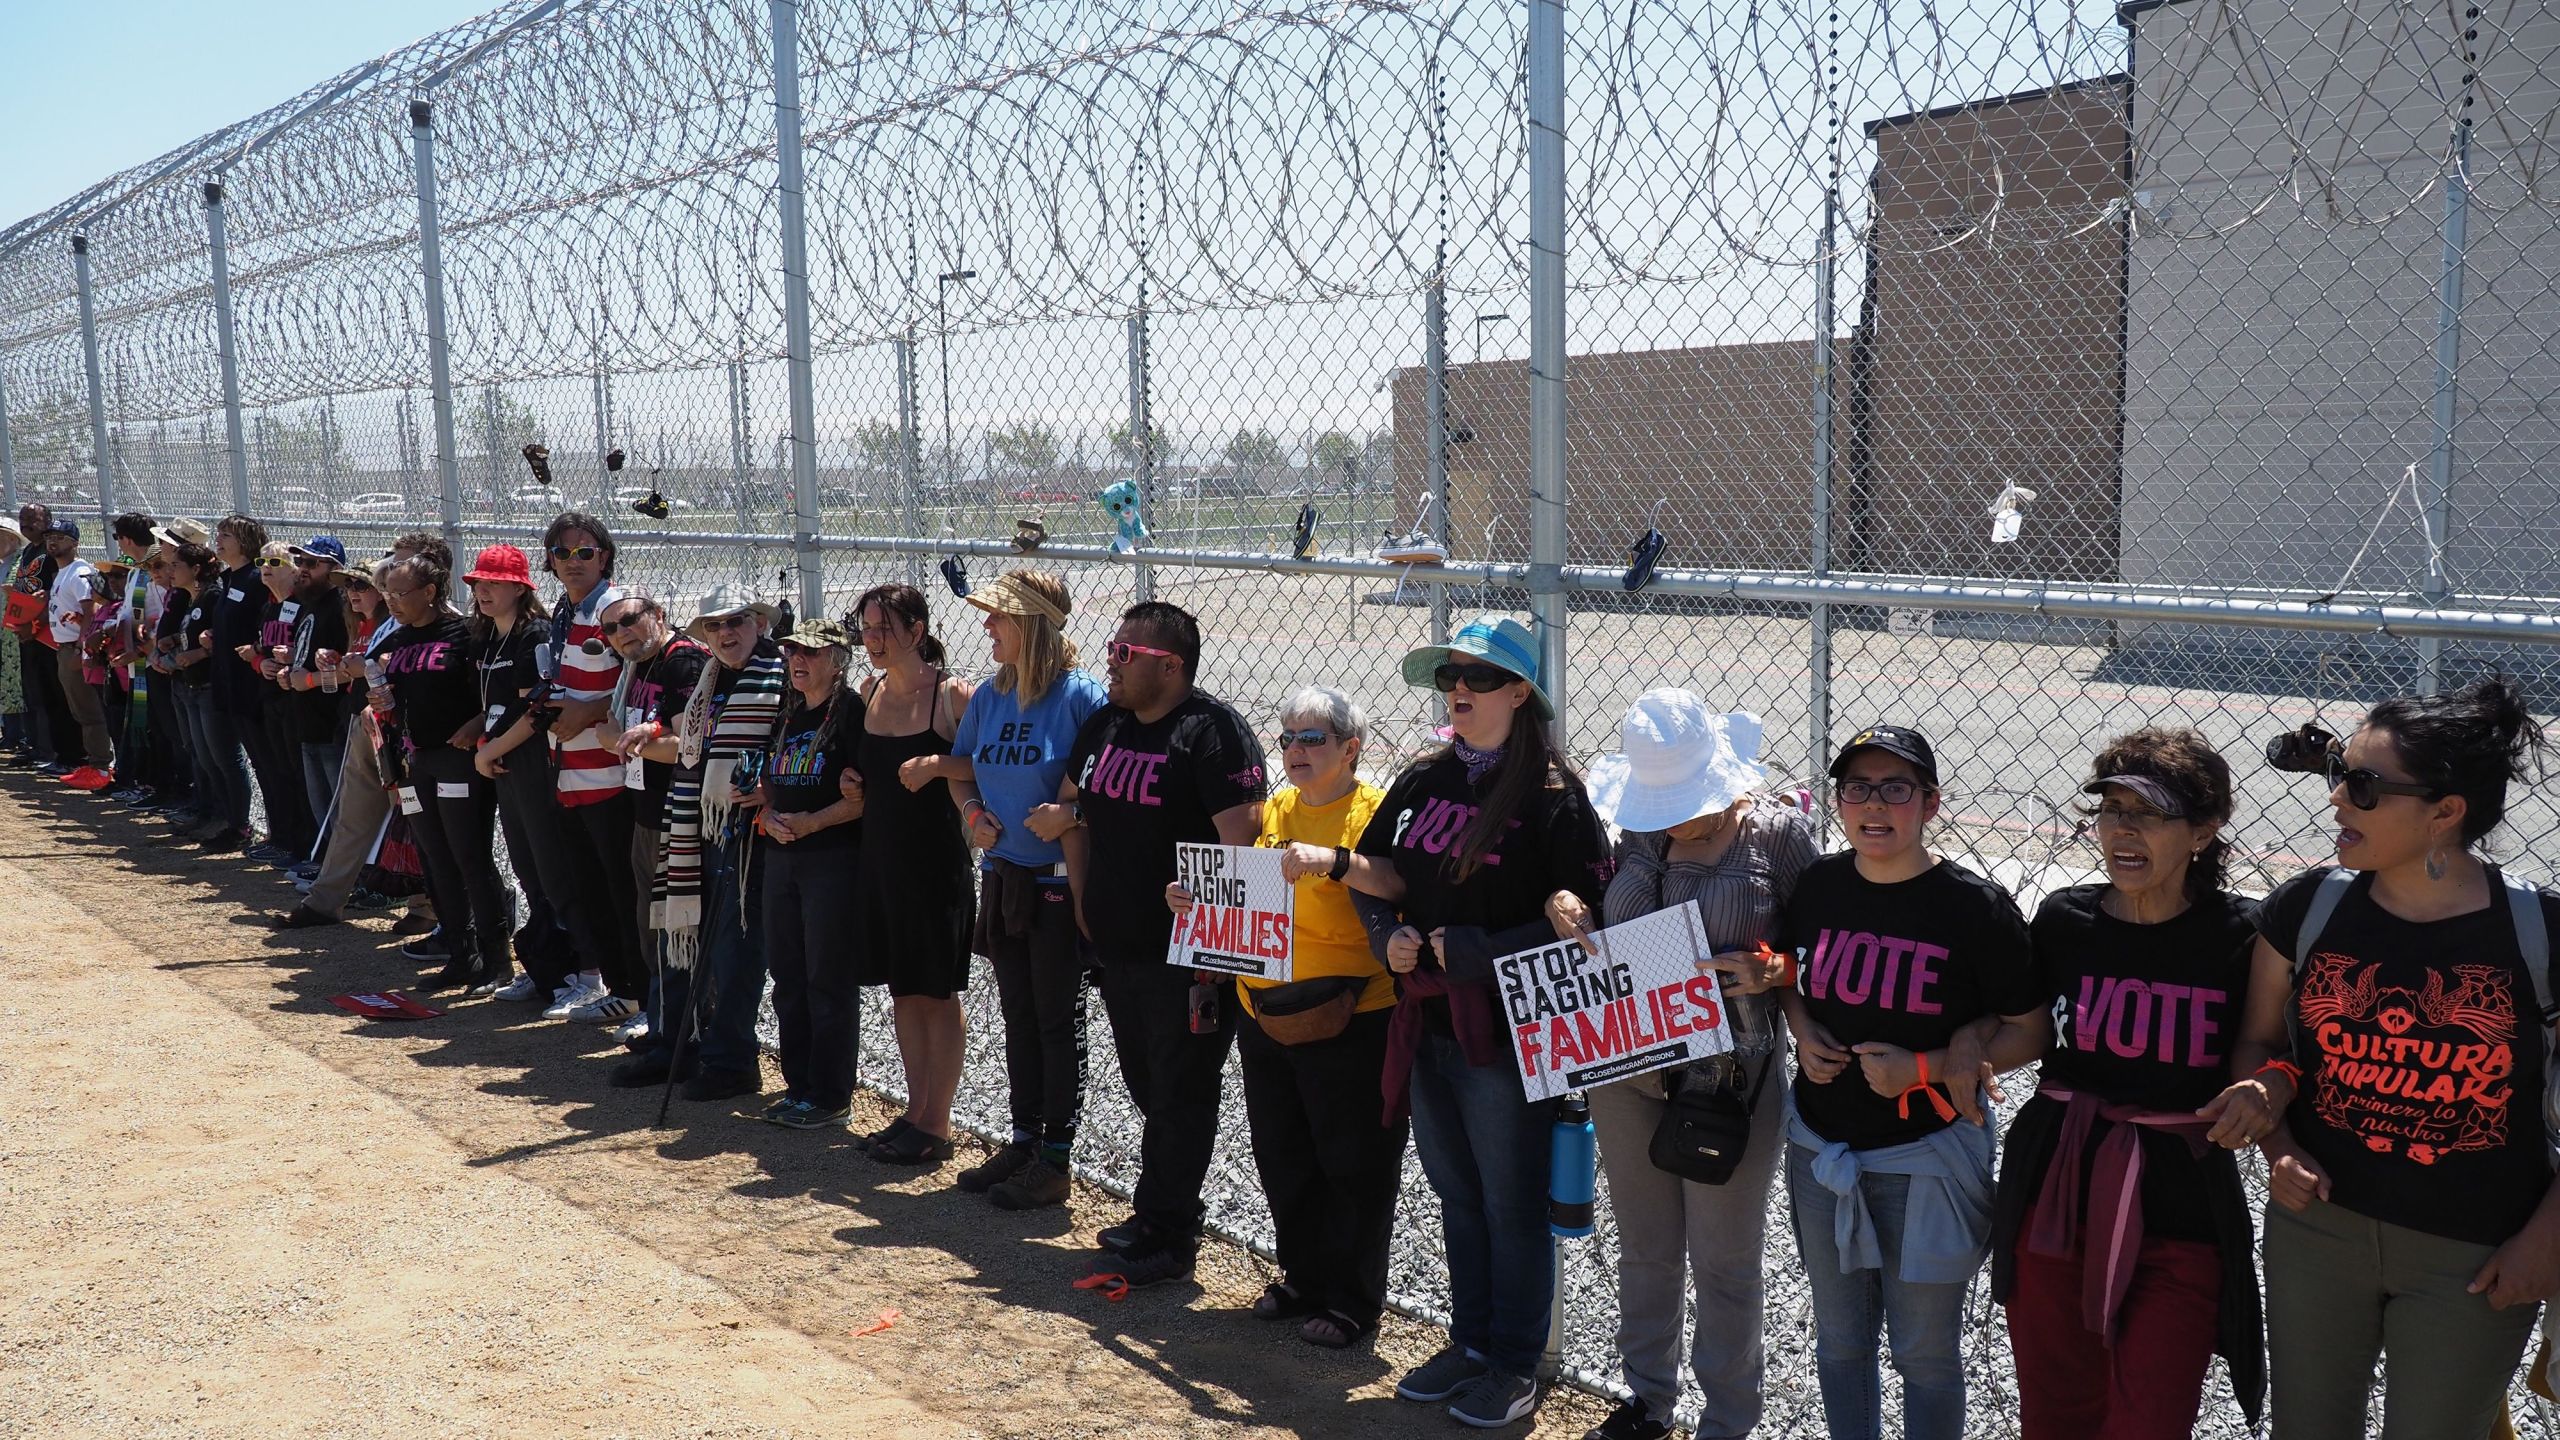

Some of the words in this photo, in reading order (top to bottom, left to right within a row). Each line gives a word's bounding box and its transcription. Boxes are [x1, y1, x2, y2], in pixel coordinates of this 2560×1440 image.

[386, 641, 453, 675] VOTE
[977, 743, 1042, 766] KIND
[999, 722, 1034, 743] BE
[800, 774, 823, 786] CITY
[1091, 743, 1168, 806] VOTE
[1179, 846, 1225, 877] STOP
[1173, 902, 1290, 960] FAMILIES
[1500, 941, 1588, 994] STOP
[1508, 962, 1634, 1026] CAGING
[1810, 928, 1950, 1015] VOTE
[1516, 975, 1722, 1078] FAMILIES
[2075, 975, 2227, 1068] VOTE
[2315, 1022, 2514, 1080] CULTURA
